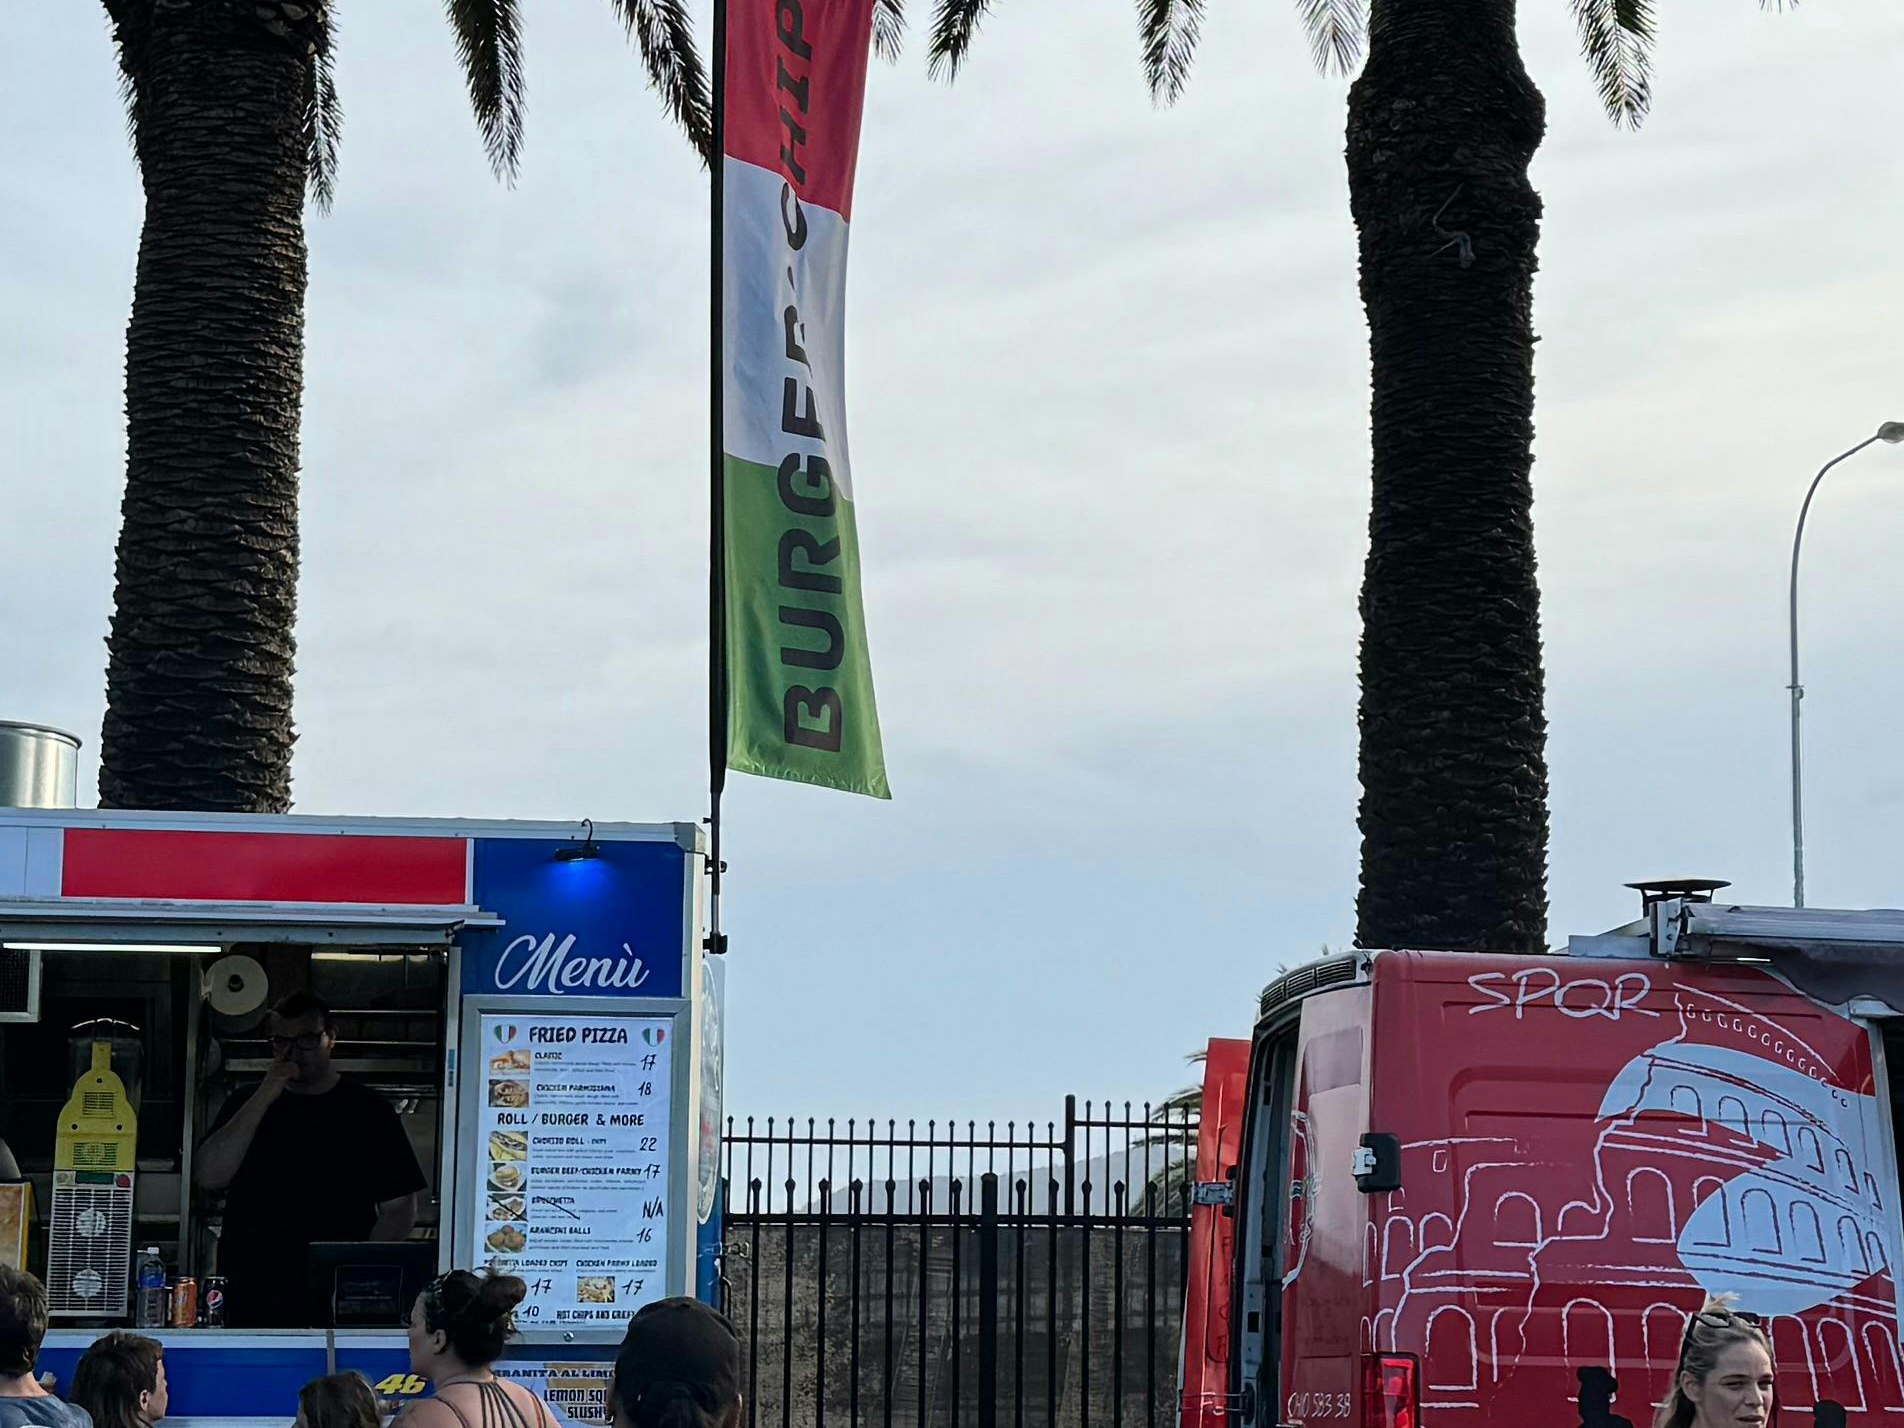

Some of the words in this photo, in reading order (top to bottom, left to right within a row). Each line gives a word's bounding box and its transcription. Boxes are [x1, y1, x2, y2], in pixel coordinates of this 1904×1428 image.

[495, 931, 650, 994] Menù
[1467, 967, 1661, 1020] SPQR
[529, 1026, 577, 1043] FRIED
[581, 1027, 628, 1044] PIZZA
[640, 1053, 657, 1071] 17
[637, 1081, 652, 1097] 18
[497, 1113, 528, 1125] ROLL
[541, 1113, 589, 1126] BURGER
[595, 1114, 606, 1126] &
[610, 1114, 645, 1126] MORE
[639, 1137, 658, 1152] 22
[642, 1195, 664, 1220] N/A
[636, 1228, 653, 1244] 16
[531, 1278, 553, 1296] 17
[622, 1279, 645, 1296] 17
[374, 1373, 426, 1395] 46
[543, 1389, 585, 1403] LEMON
